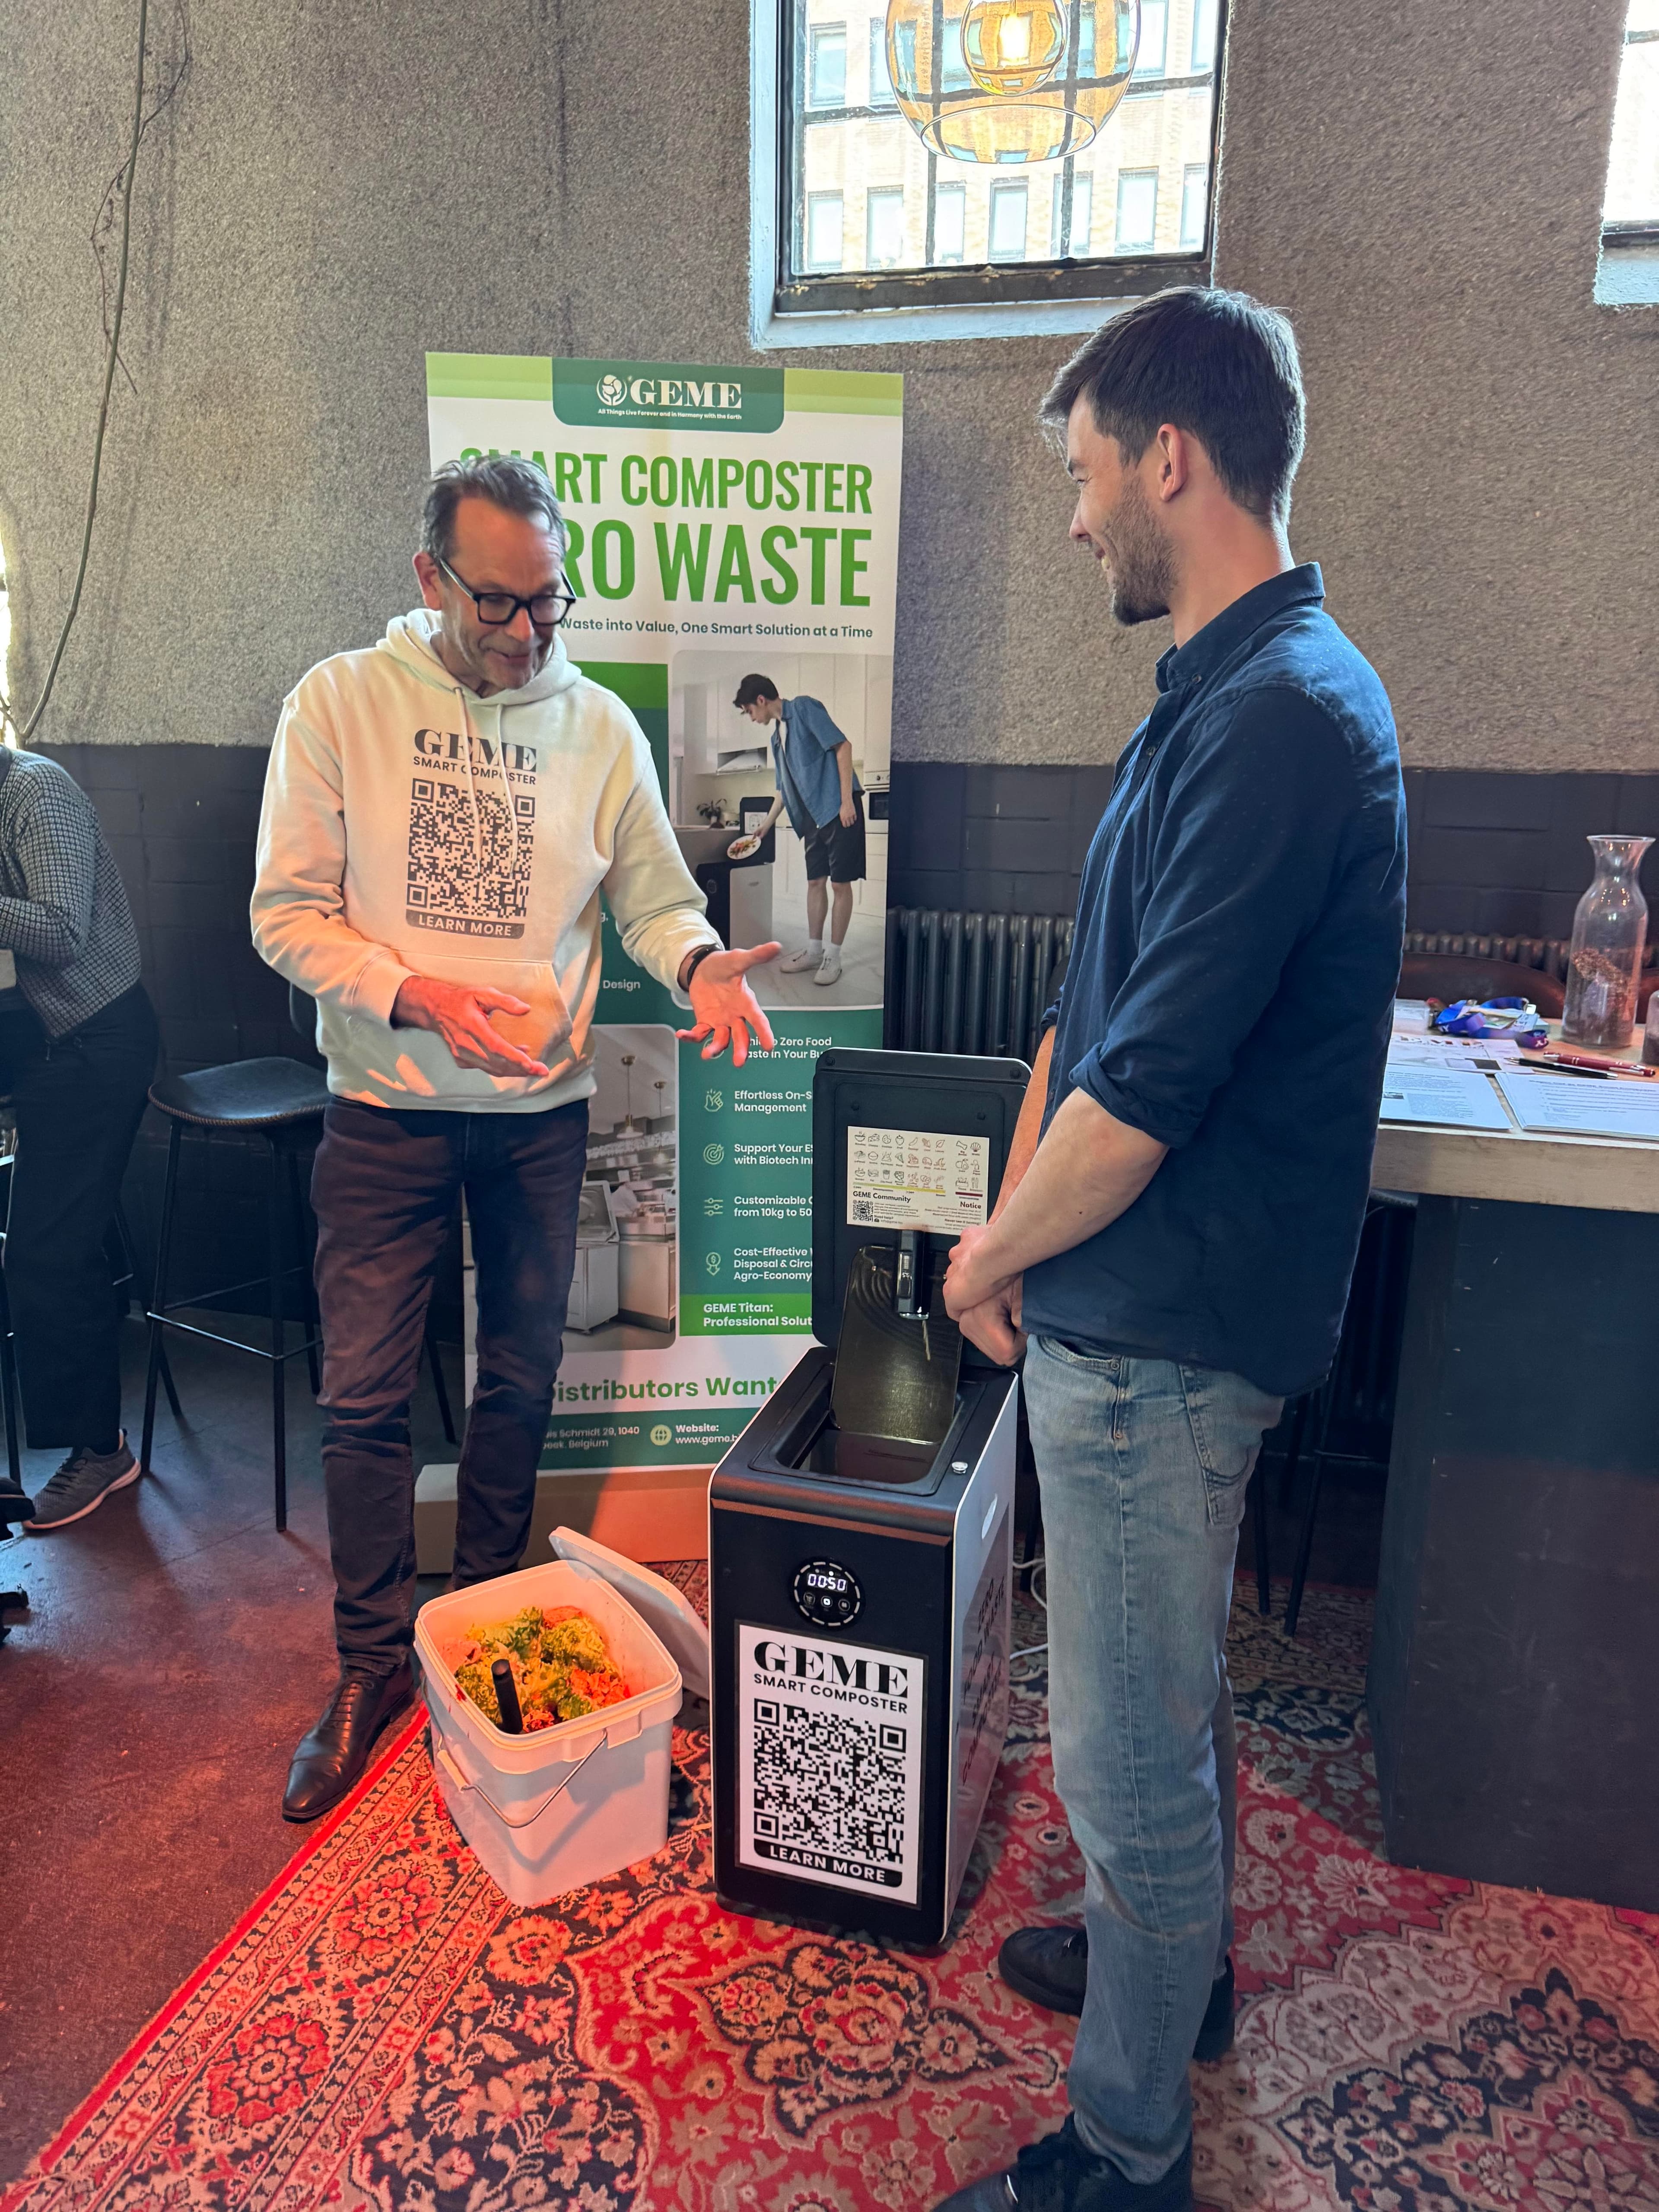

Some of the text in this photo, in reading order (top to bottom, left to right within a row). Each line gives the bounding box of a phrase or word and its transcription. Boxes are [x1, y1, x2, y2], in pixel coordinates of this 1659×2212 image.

[630, 378, 742, 409] GEME
[621, 454, 872, 514] COMPOSTER
[563, 518, 872, 607] RO WASTE
[606, 618, 632, 631] into
[636, 620, 678, 635] Value,
[681, 622, 708, 634] One
[711, 623, 753, 635] Smart
[756, 623, 810, 636] Solution
[813, 626, 827, 636] at
[830, 628, 839, 636] a
[841, 626, 873, 638] Time
[414, 729, 537, 772] GEME
[413, 756, 458, 772] SMART
[419, 914, 512, 936] LEARN MORE
[603, 979, 641, 992] Design
[780, 1037, 804, 1046] Zero
[806, 1037, 832, 1046] Food
[748, 1049, 769, 1058] aste
[784, 1049, 808, 1058] Your
[734, 1090, 783, 1100] Effortless
[734, 1103, 807, 1114] Management
[734, 1144, 776, 1155] Support
[779, 1144, 804, 1153] Your
[734, 1155, 757, 1164] with
[759, 1156, 799, 1164] Biotech
[734, 1195, 806, 1205] Customizable
[873, 1193, 911, 1203] Community
[734, 1208, 760, 1217] from
[761, 1208, 784, 1219] 10kg
[786, 1208, 797, 1217] to
[734, 1247, 808, 1256] Cost-Effective
[734, 1259, 778, 1271] Disposal
[780, 1259, 788, 1268] &
[734, 1271, 813, 1282] Agro-Economy
[703, 1302, 774, 1313] GEME Titan:
[703, 1316, 779, 1327] Professional
[553, 1379, 699, 1402] istributors
[618, 1426, 640, 1435] 1040
[675, 1423, 719, 1433] Website:
[754, 1641, 908, 1699] GEME
[753, 1673, 908, 1714] SMART COMPOSTER
[769, 1845, 885, 1883] LEARN MORE
